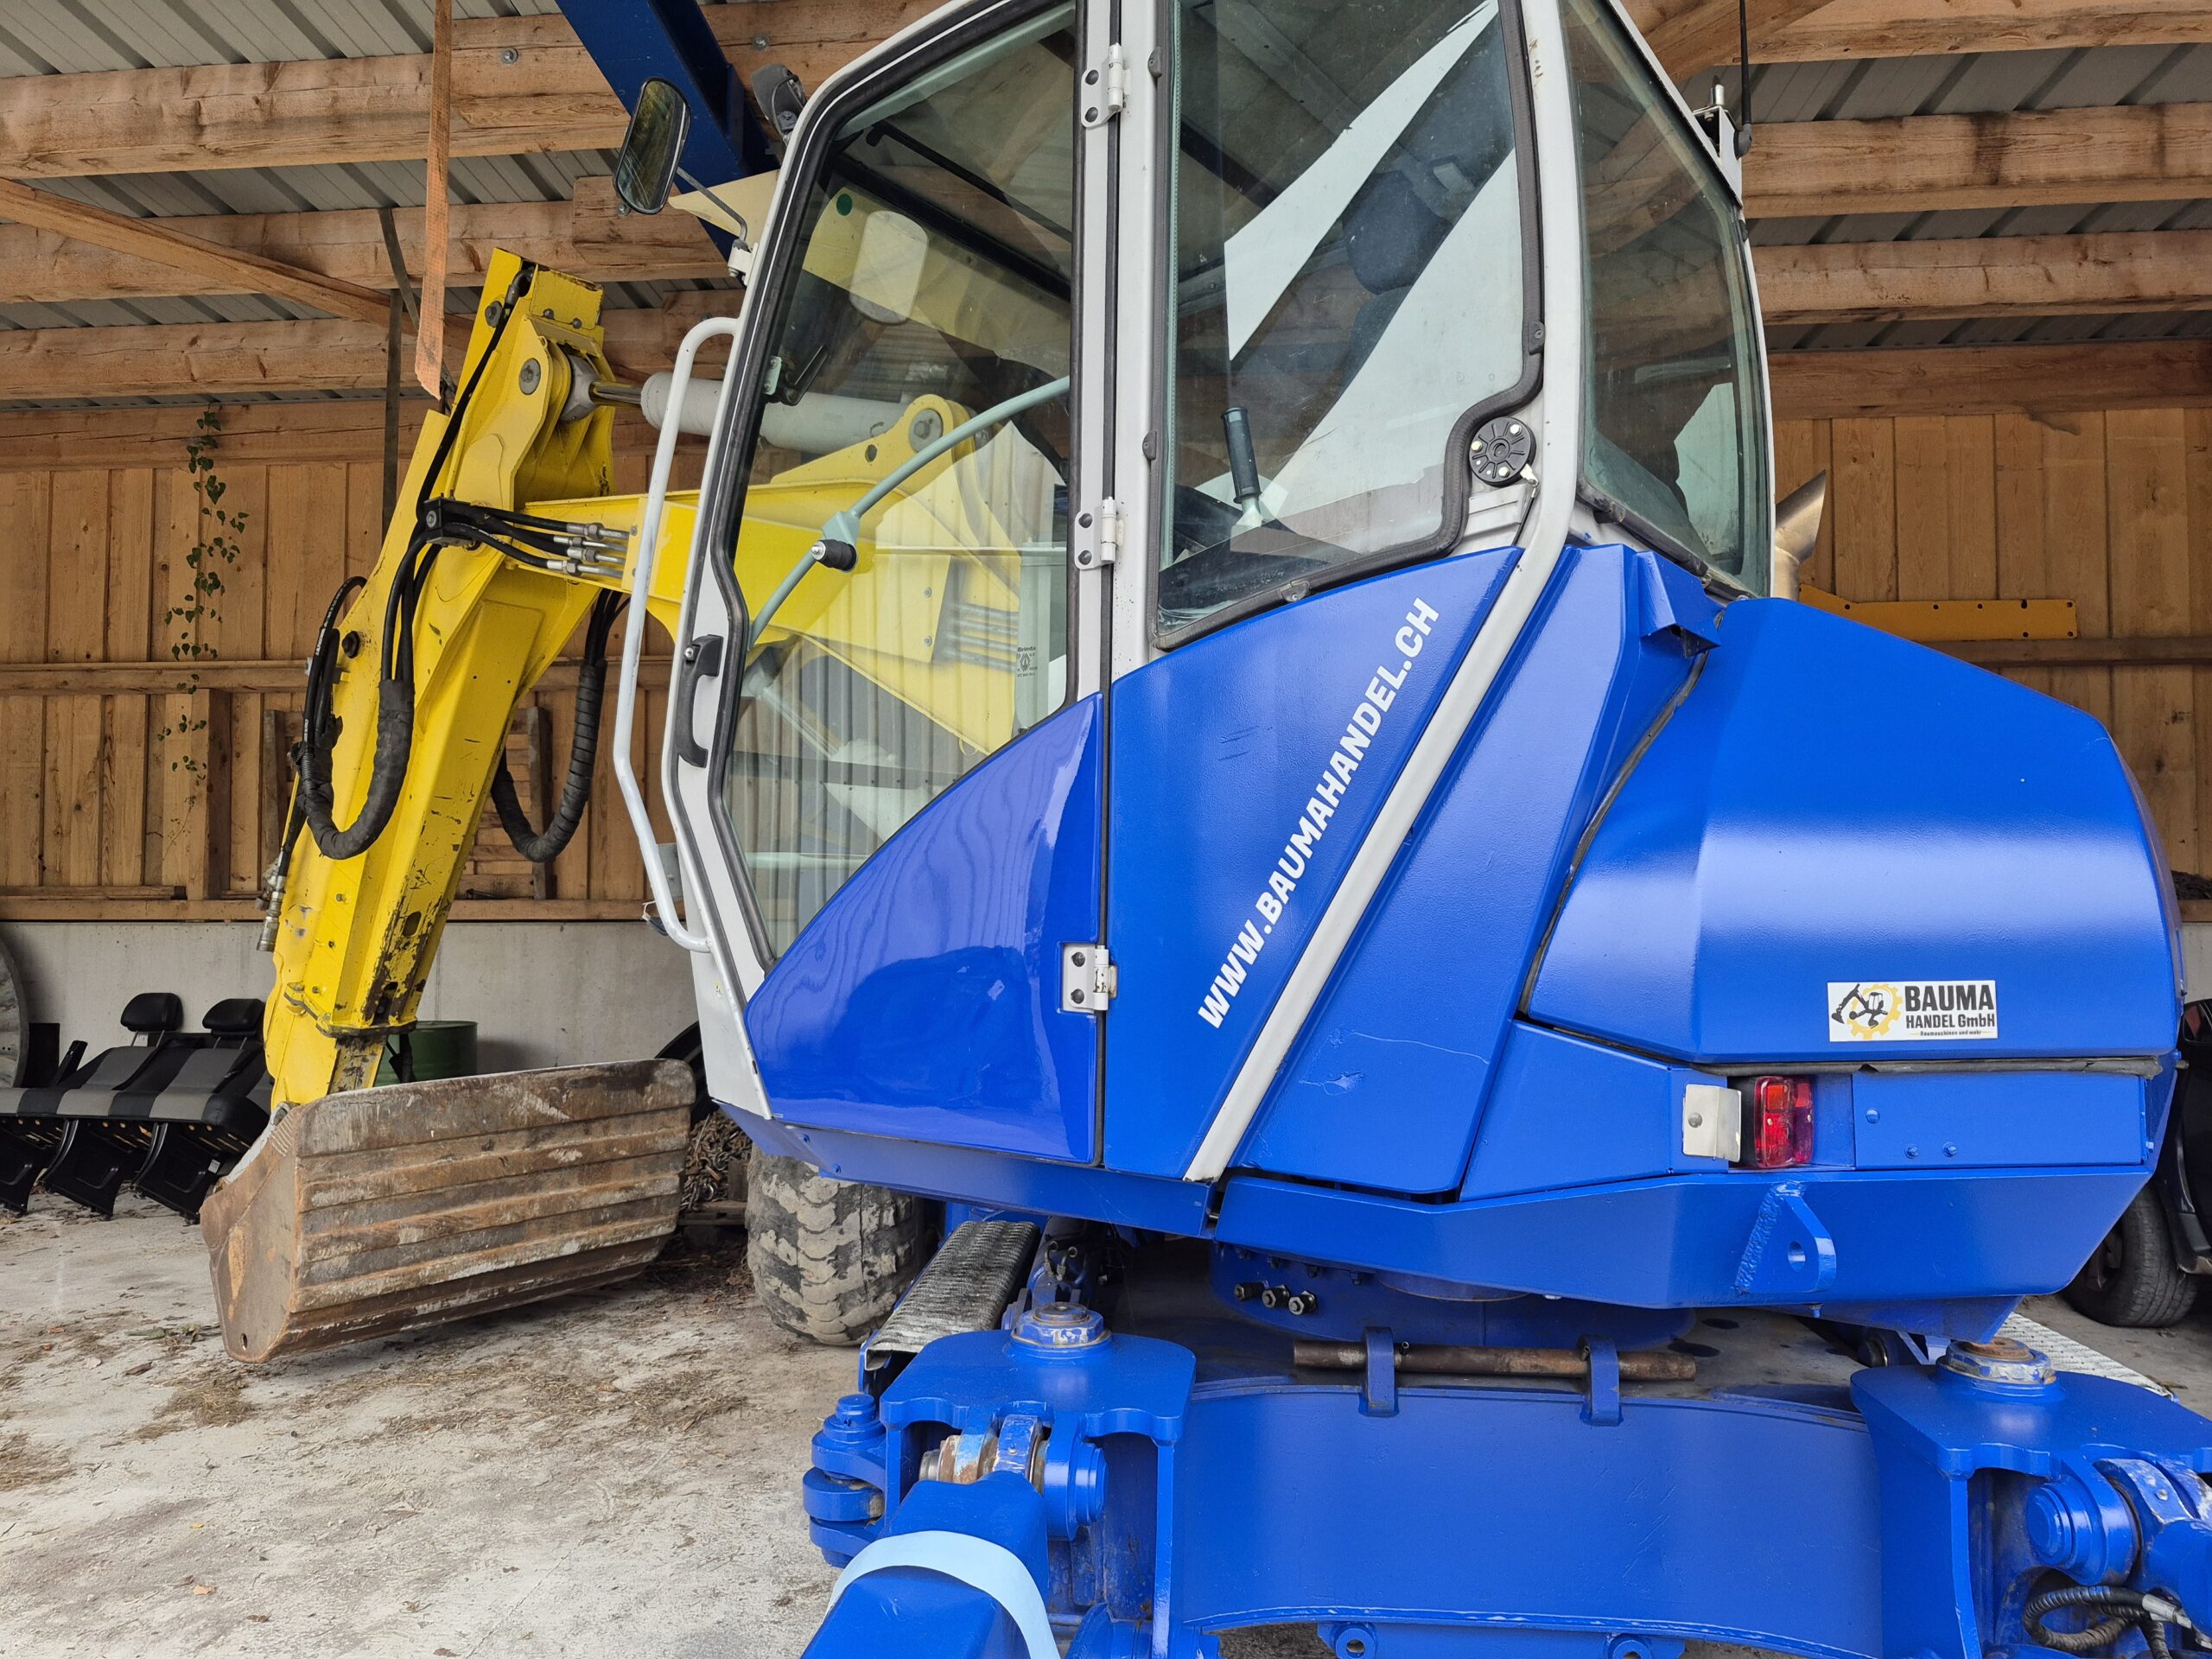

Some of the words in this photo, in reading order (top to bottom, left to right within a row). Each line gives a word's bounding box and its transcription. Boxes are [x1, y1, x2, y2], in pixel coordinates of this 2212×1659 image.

[1198, 597, 1440, 1029] WWW.BAUMAHANDEL.CH
[1904, 984, 1994, 1012] BAUMA
[1906, 1014, 1955, 1029] HANDEL
[1958, 1013, 1995, 1028] GmbH
